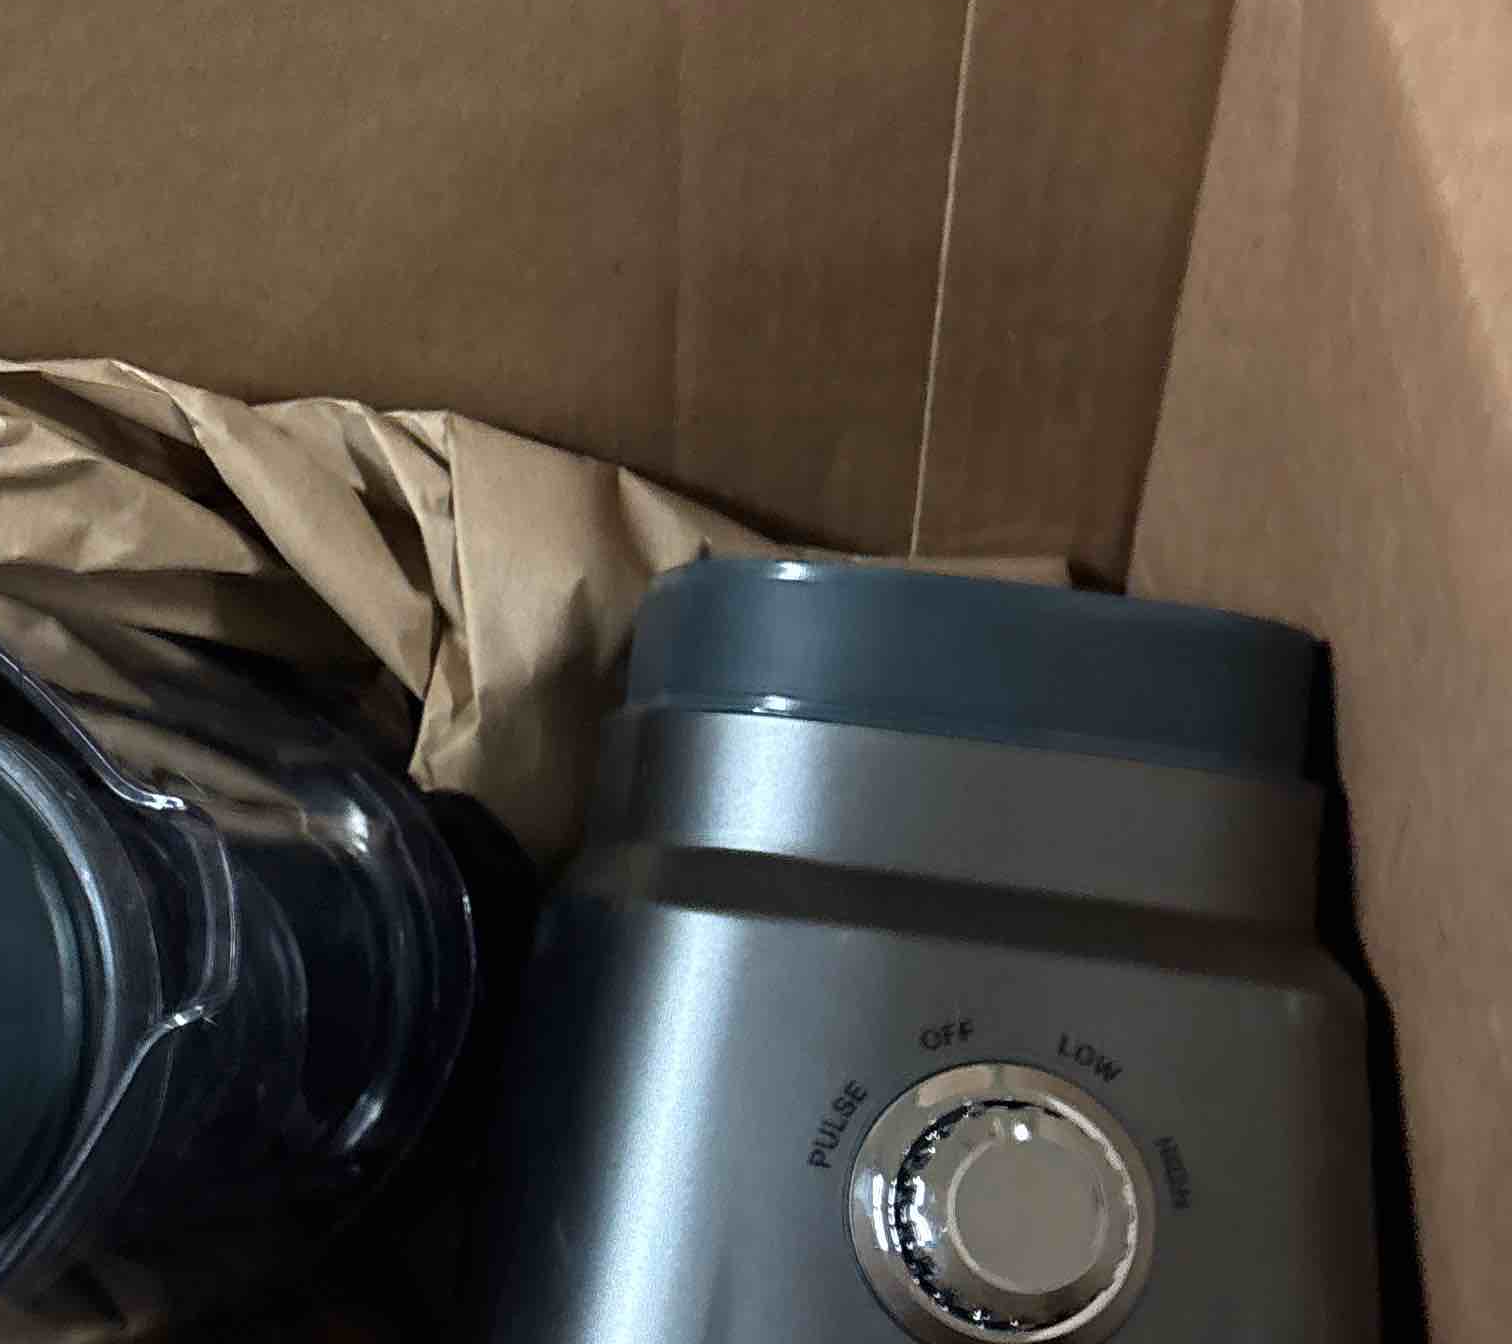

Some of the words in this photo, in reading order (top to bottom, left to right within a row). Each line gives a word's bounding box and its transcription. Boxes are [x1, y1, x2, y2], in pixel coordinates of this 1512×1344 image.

[918, 1017, 975, 1051] OFF
[1056, 1031, 1123, 1084] LOW
[806, 1078, 868, 1169] PULSE
